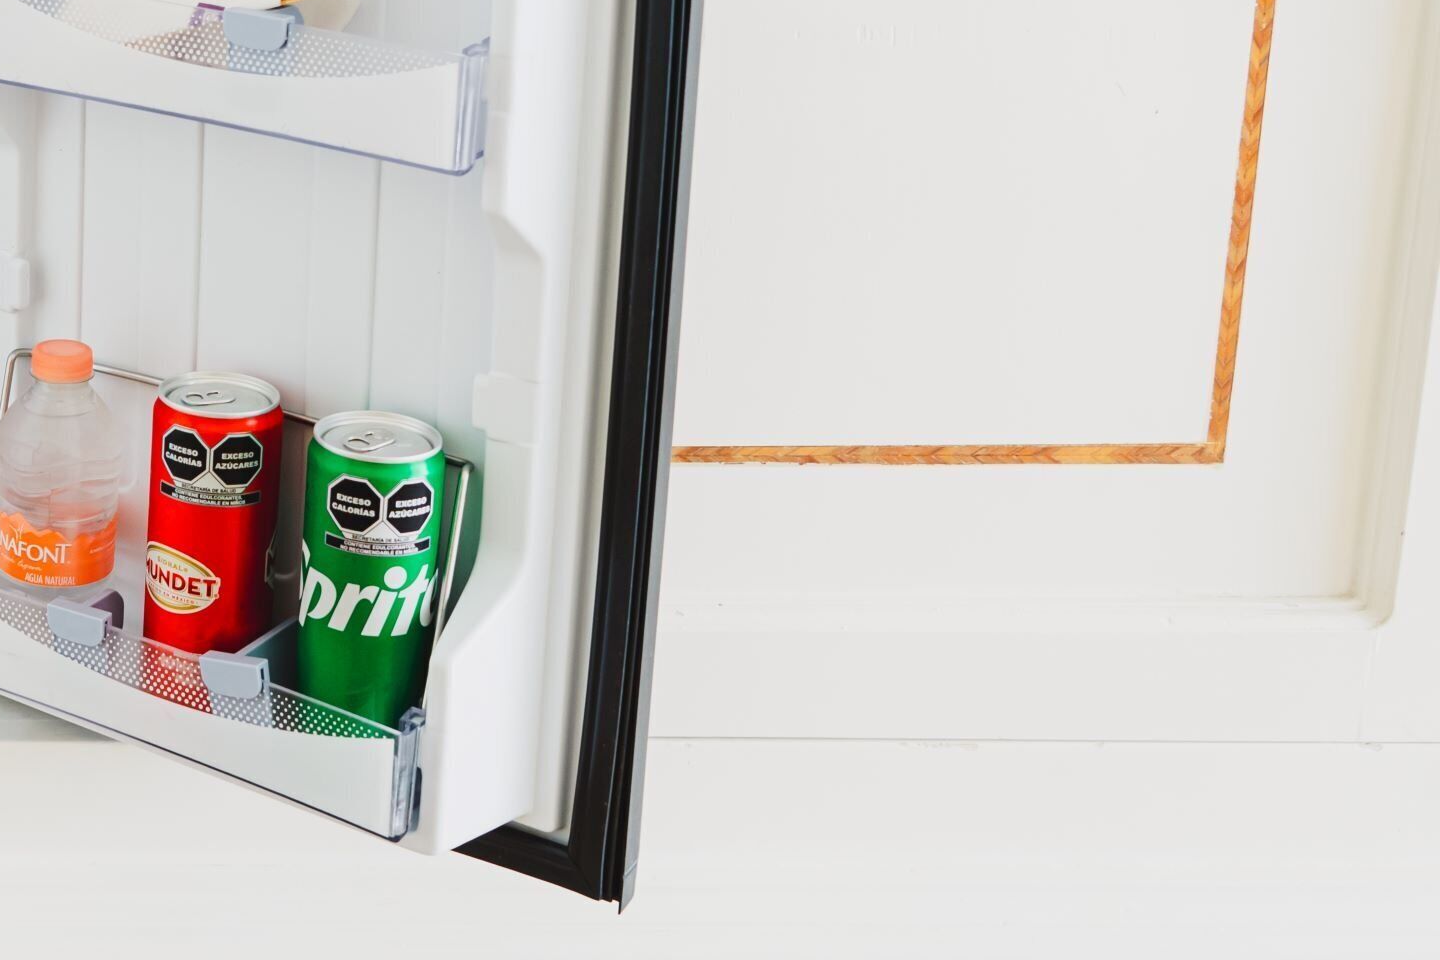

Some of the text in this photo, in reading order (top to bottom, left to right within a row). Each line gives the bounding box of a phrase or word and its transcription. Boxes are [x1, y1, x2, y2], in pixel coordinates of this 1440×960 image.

[168, 442, 198, 456] EXCESO
[166, 452, 202, 468] CALORÍAS
[222, 452, 254, 460] EXCESO
[215, 460, 259, 470] AZÚCARES
[174, 488, 198, 498] CONTIENE
[336, 493, 372, 506] EXCESO
[395, 496, 427, 508] EXCESO
[332, 502, 376, 518] CALORÍAS
[388, 506, 431, 518] AZÚCARES
[344, 540, 371, 549] CONTIENE
[24, 572, 76, 586] AGUA NATURAL
